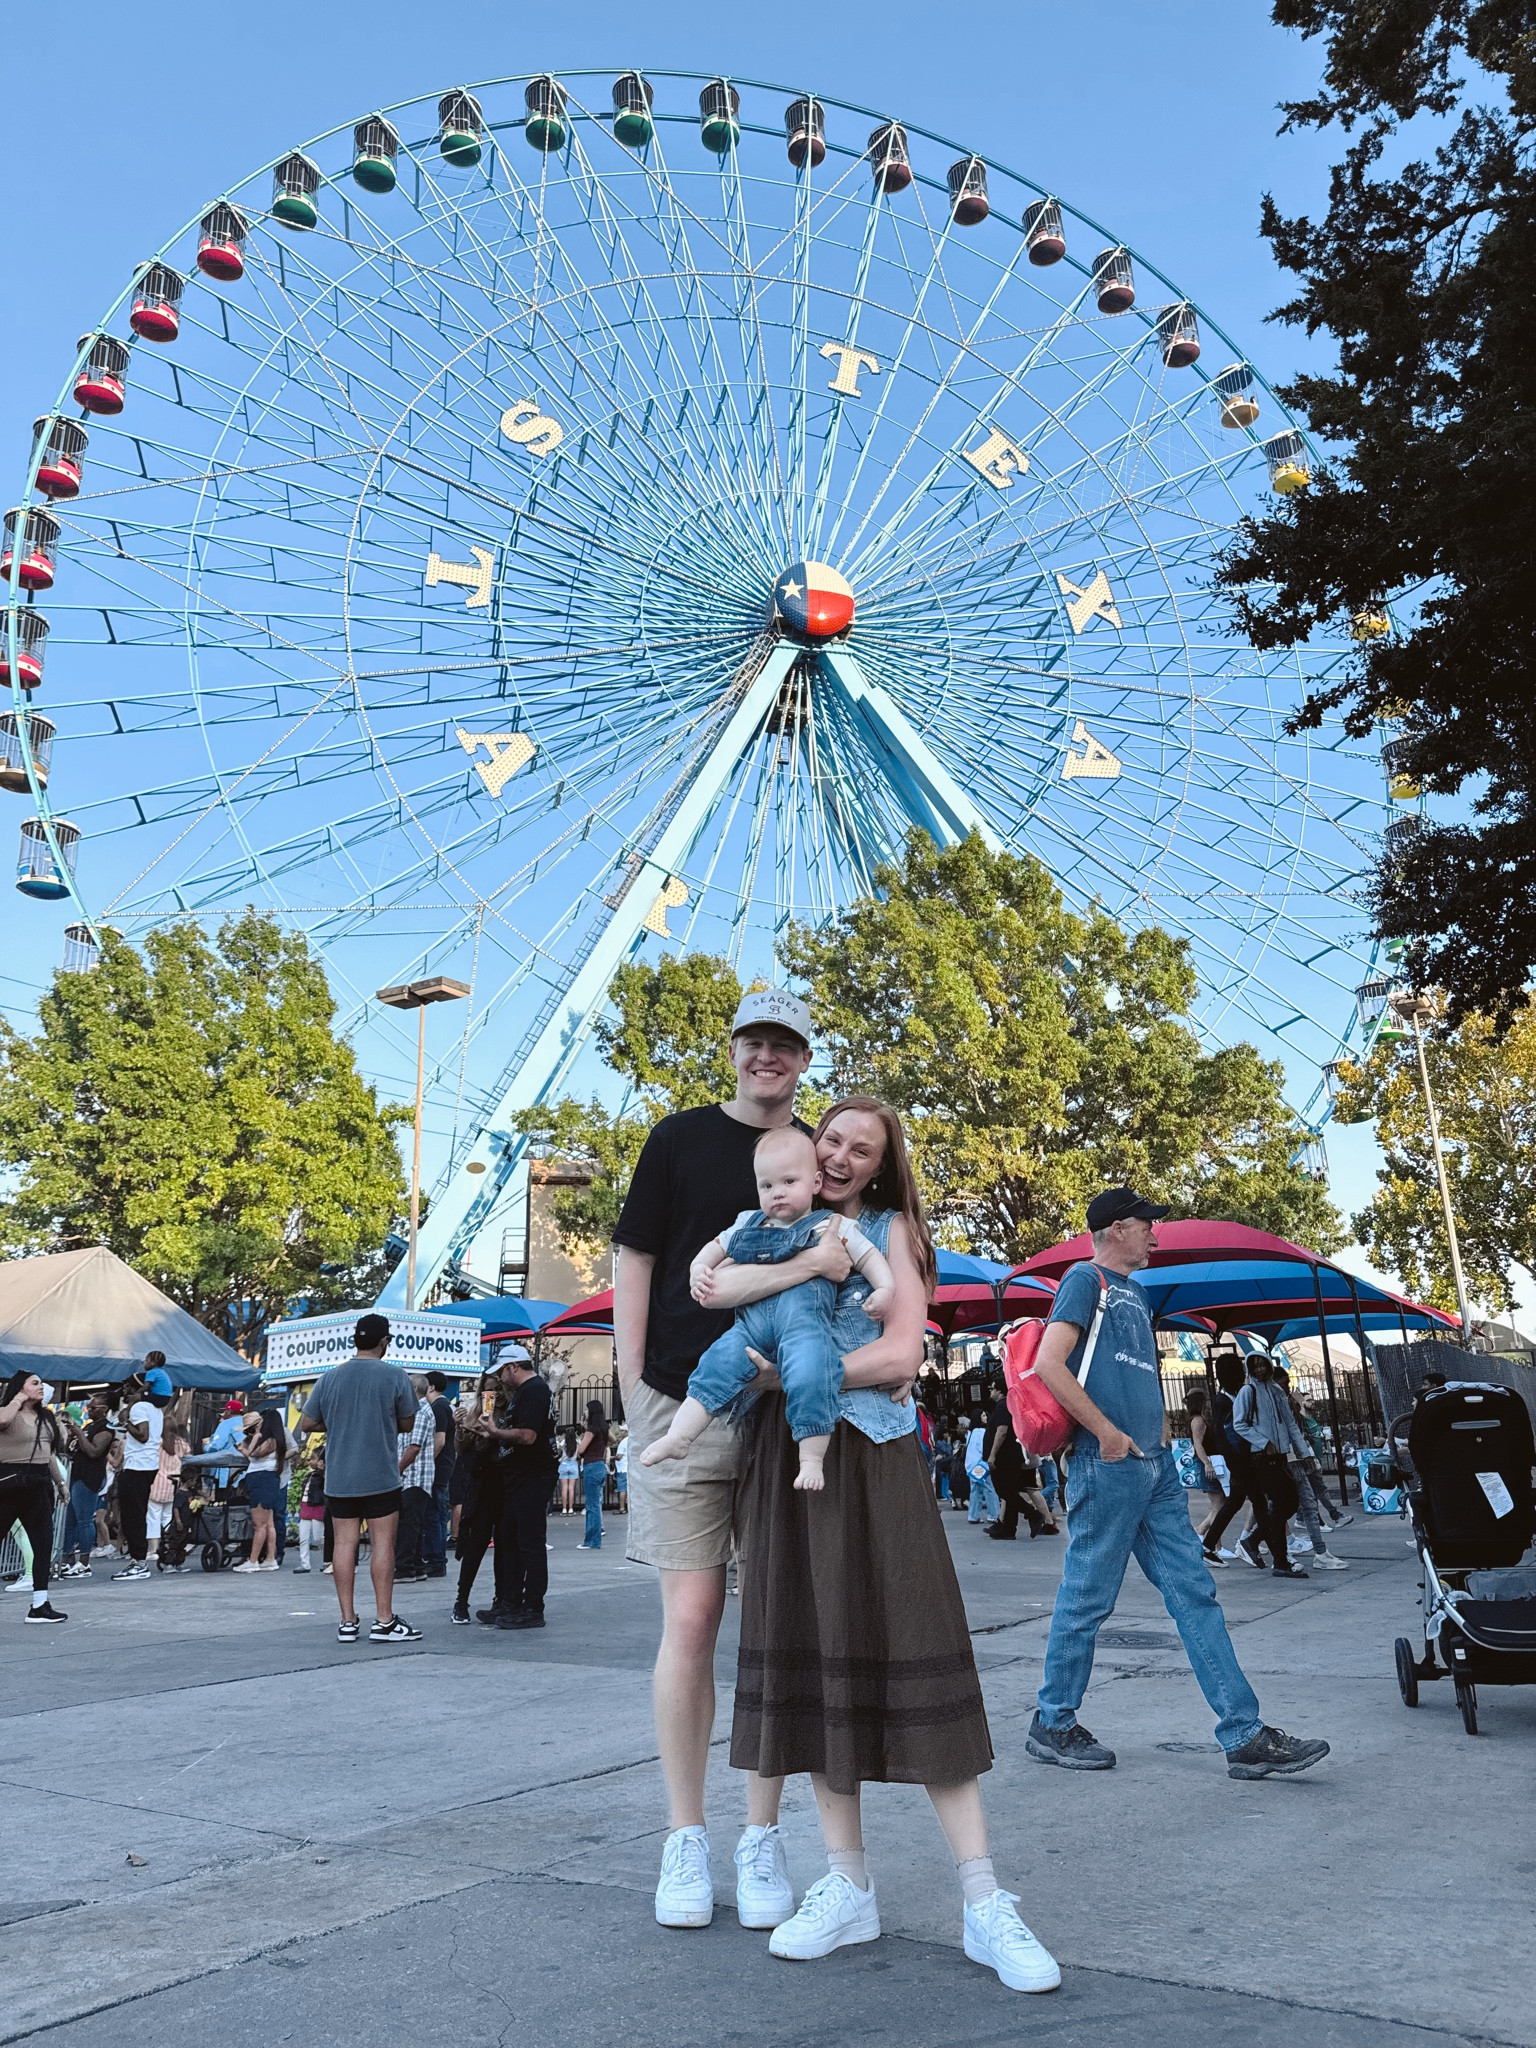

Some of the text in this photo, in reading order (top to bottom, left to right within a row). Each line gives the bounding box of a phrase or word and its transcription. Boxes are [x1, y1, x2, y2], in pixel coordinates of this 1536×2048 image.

[752, 996, 799, 1014] SEAGER
[286, 1334, 355, 1358] COUPONS
[395, 1333, 464, 1354] COUPONS
